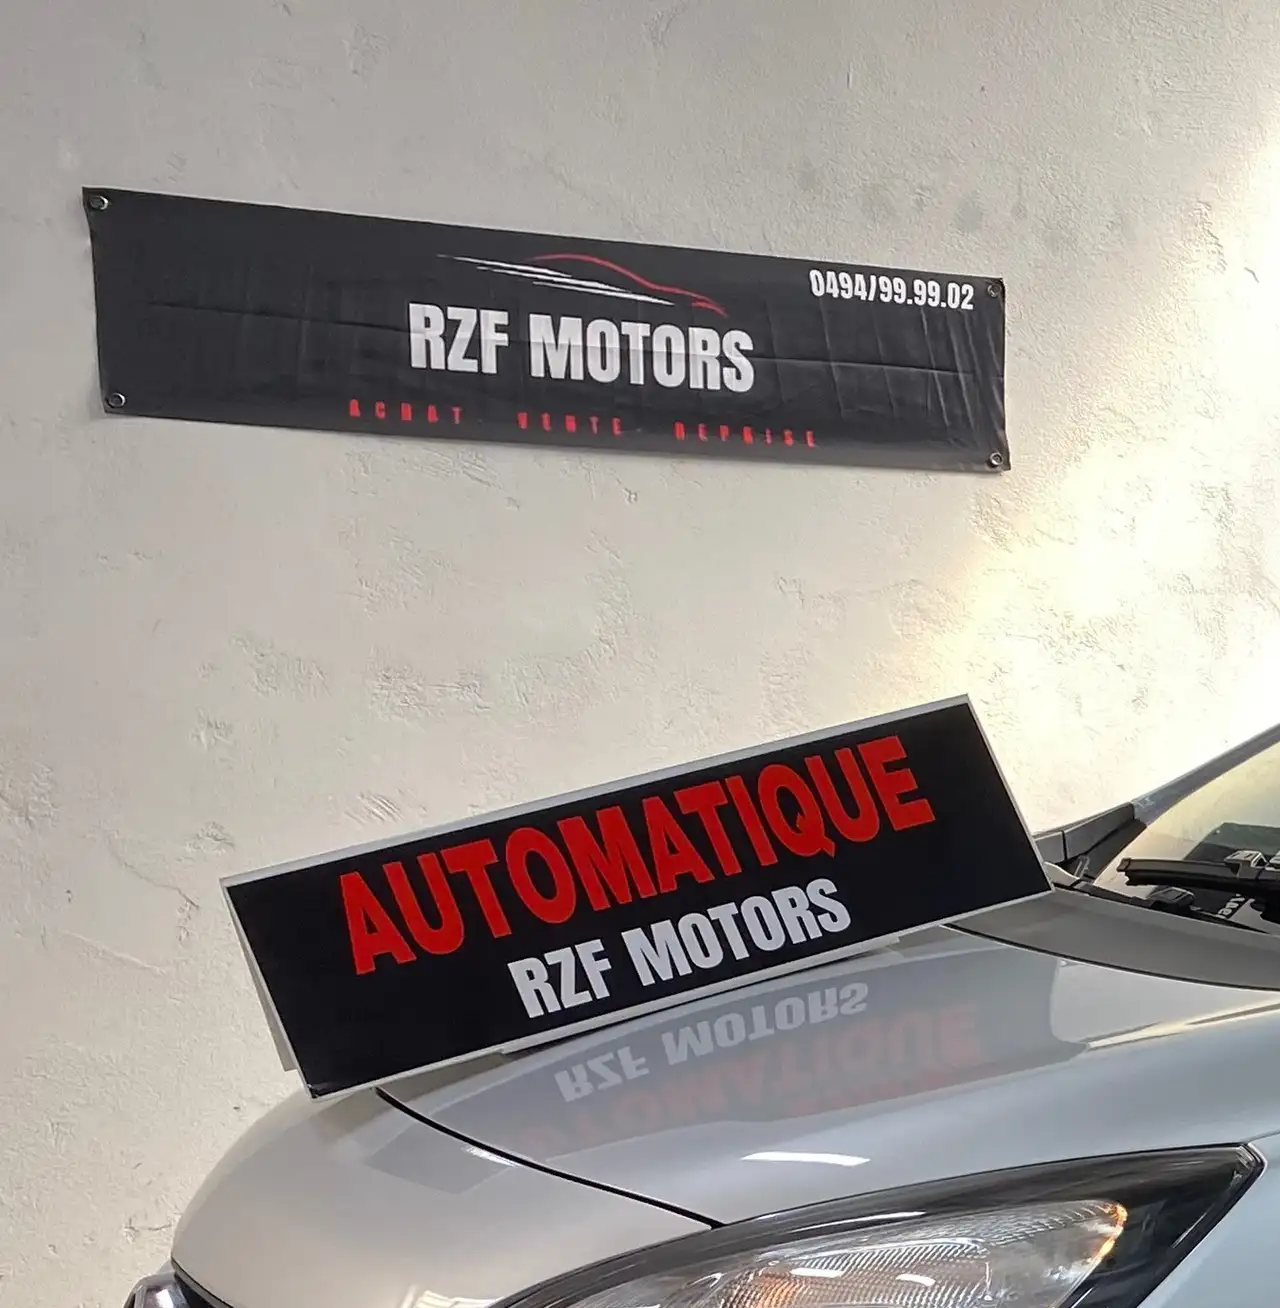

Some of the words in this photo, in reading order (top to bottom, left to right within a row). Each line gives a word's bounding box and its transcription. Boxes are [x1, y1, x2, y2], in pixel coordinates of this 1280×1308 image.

[408, 302, 509, 374] RZF
[529, 313, 755, 393] MOTORS
[809, 269, 974, 310] 0494/99.99.02
[338, 735, 936, 976] AUTOMATIQUE
[507, 937, 612, 1019] RZF
[621, 877, 852, 988] MOTORS
